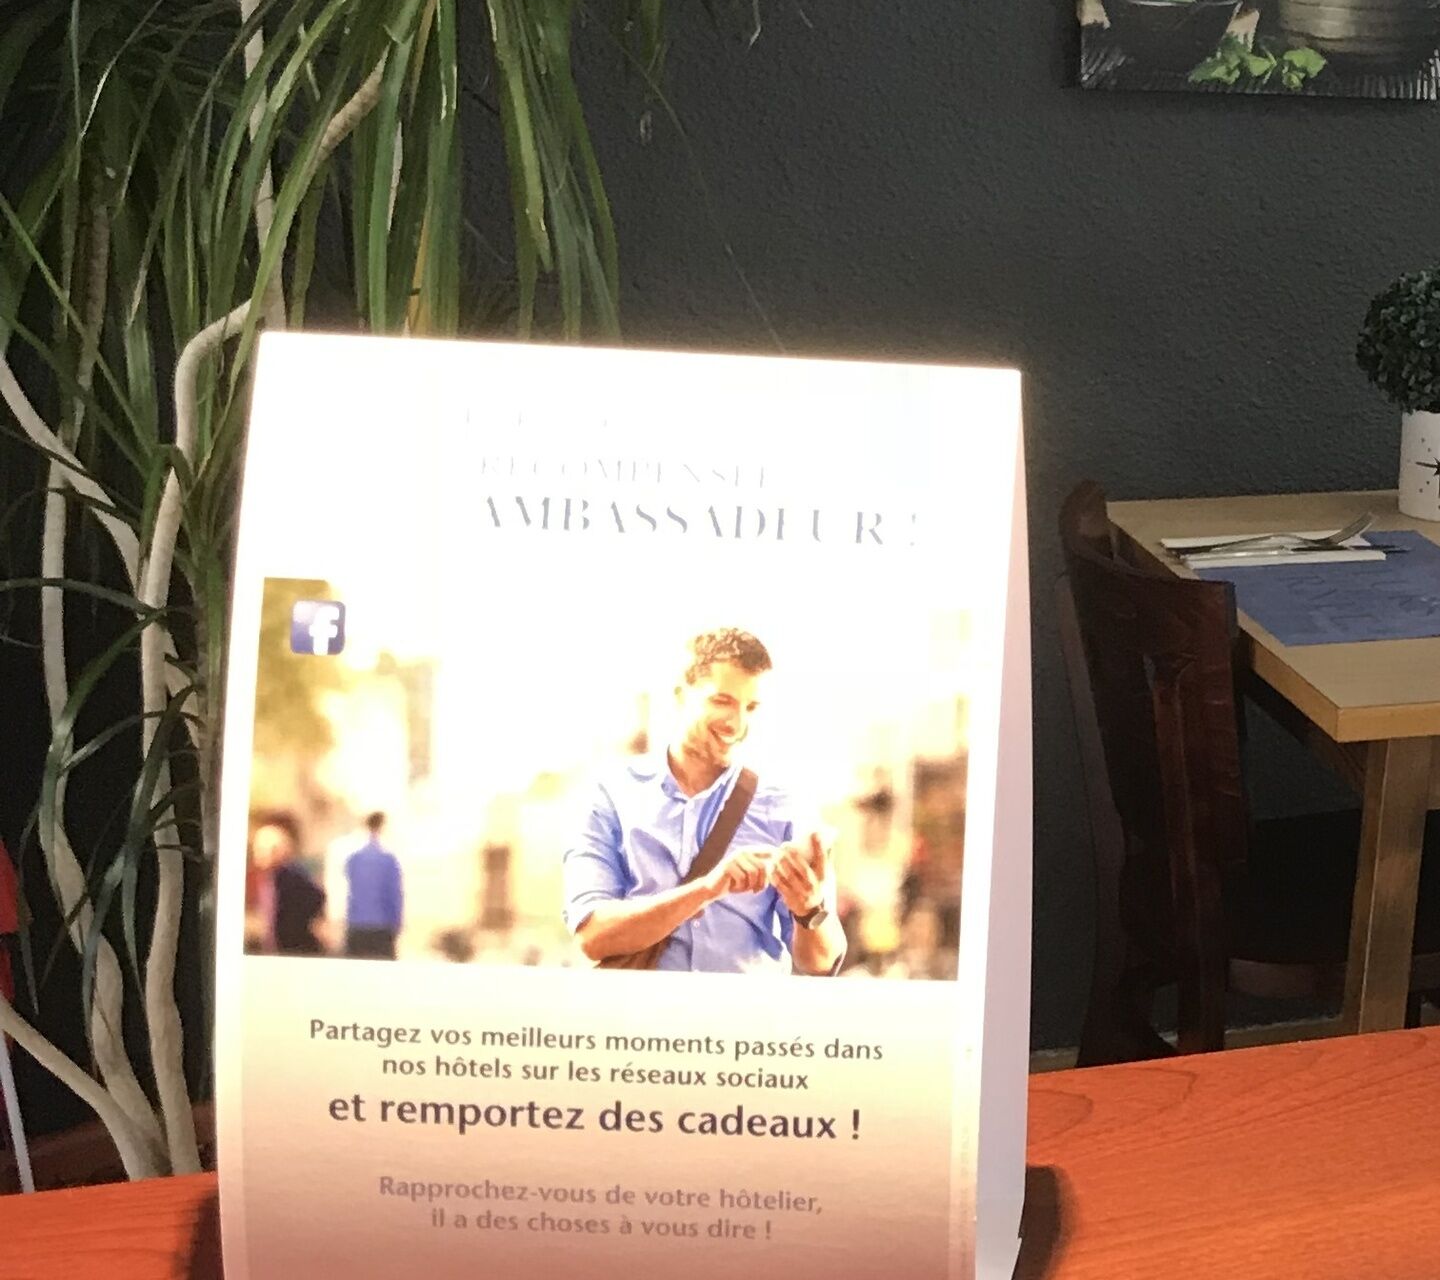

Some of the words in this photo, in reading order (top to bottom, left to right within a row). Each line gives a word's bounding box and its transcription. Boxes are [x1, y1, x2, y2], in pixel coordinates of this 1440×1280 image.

[309, 1018, 422, 1049] Partagez
[429, 1028, 472, 1046] vos
[480, 1026, 597, 1051] meilleurs
[604, 1035, 726, 1056] moments
[734, 1032, 816, 1062] passés
[823, 1037, 884, 1062] dans
[381, 1058, 427, 1076] nos
[434, 1055, 513, 1080] hôtels
[521, 1063, 560, 1081] sur
[567, 1059, 602, 1083] les
[609, 1062, 707, 1086] réseaux
[716, 1066, 810, 1091] sociaux
[327, 1093, 367, 1123] et
[379, 1095, 585, 1136] remportez
[598, 1101, 664, 1134] des
[676, 1105, 837, 1140] cadeaux
[850, 1108, 862, 1141] !
[379, 1175, 597, 1207] Rapprochez-vous
[604, 1183, 640, 1207] de
[643, 1186, 711, 1209] votre
[716, 1186, 823, 1216] hôtelier,
[430, 1207, 445, 1228] il
[453, 1214, 470, 1230] a
[475, 1209, 519, 1232] des
[526, 1210, 611, 1235] choses
[618, 1214, 633, 1235] à
[640, 1221, 699, 1238] vous
[706, 1217, 757, 1240] dire
[764, 1218, 773, 1241] !
